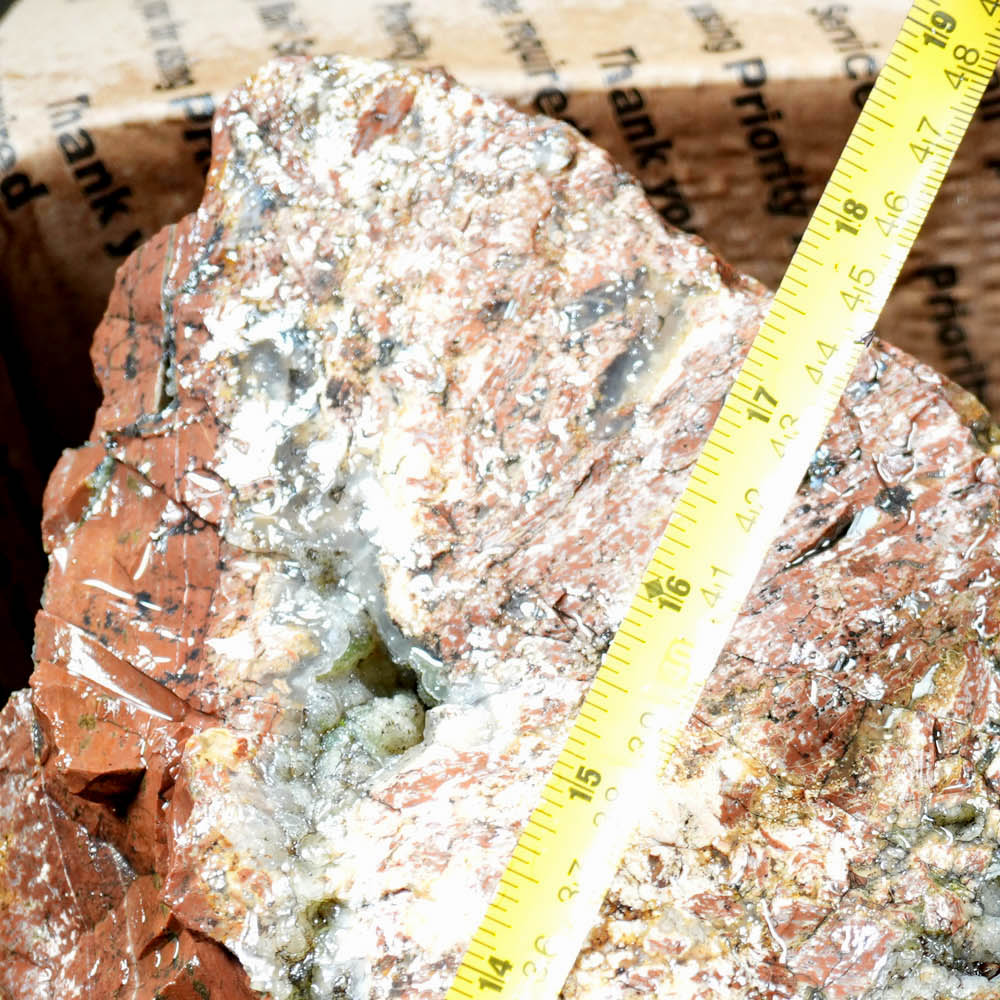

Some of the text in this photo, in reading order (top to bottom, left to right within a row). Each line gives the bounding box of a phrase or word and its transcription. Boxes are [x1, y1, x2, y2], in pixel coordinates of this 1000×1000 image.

[922, 9, 957, 49] 19
[943, 44, 980, 90] 48
[594, 46, 674, 174] Thank
[45, 94, 134, 229] Thank
[724, 58, 808, 217] Priority
[909, 114, 947, 165] 47
[834, 199, 869, 238] 18
[874, 189, 911, 239] 46
[840, 261, 876, 313] 45
[919, 264, 986, 405] Priorit
[803, 337, 839, 387] 44
[746, 384, 778, 425] 17
[658, 574, 693, 614] 16
[567, 764, 603, 804] 15
[477, 954, 515, 994] 14
